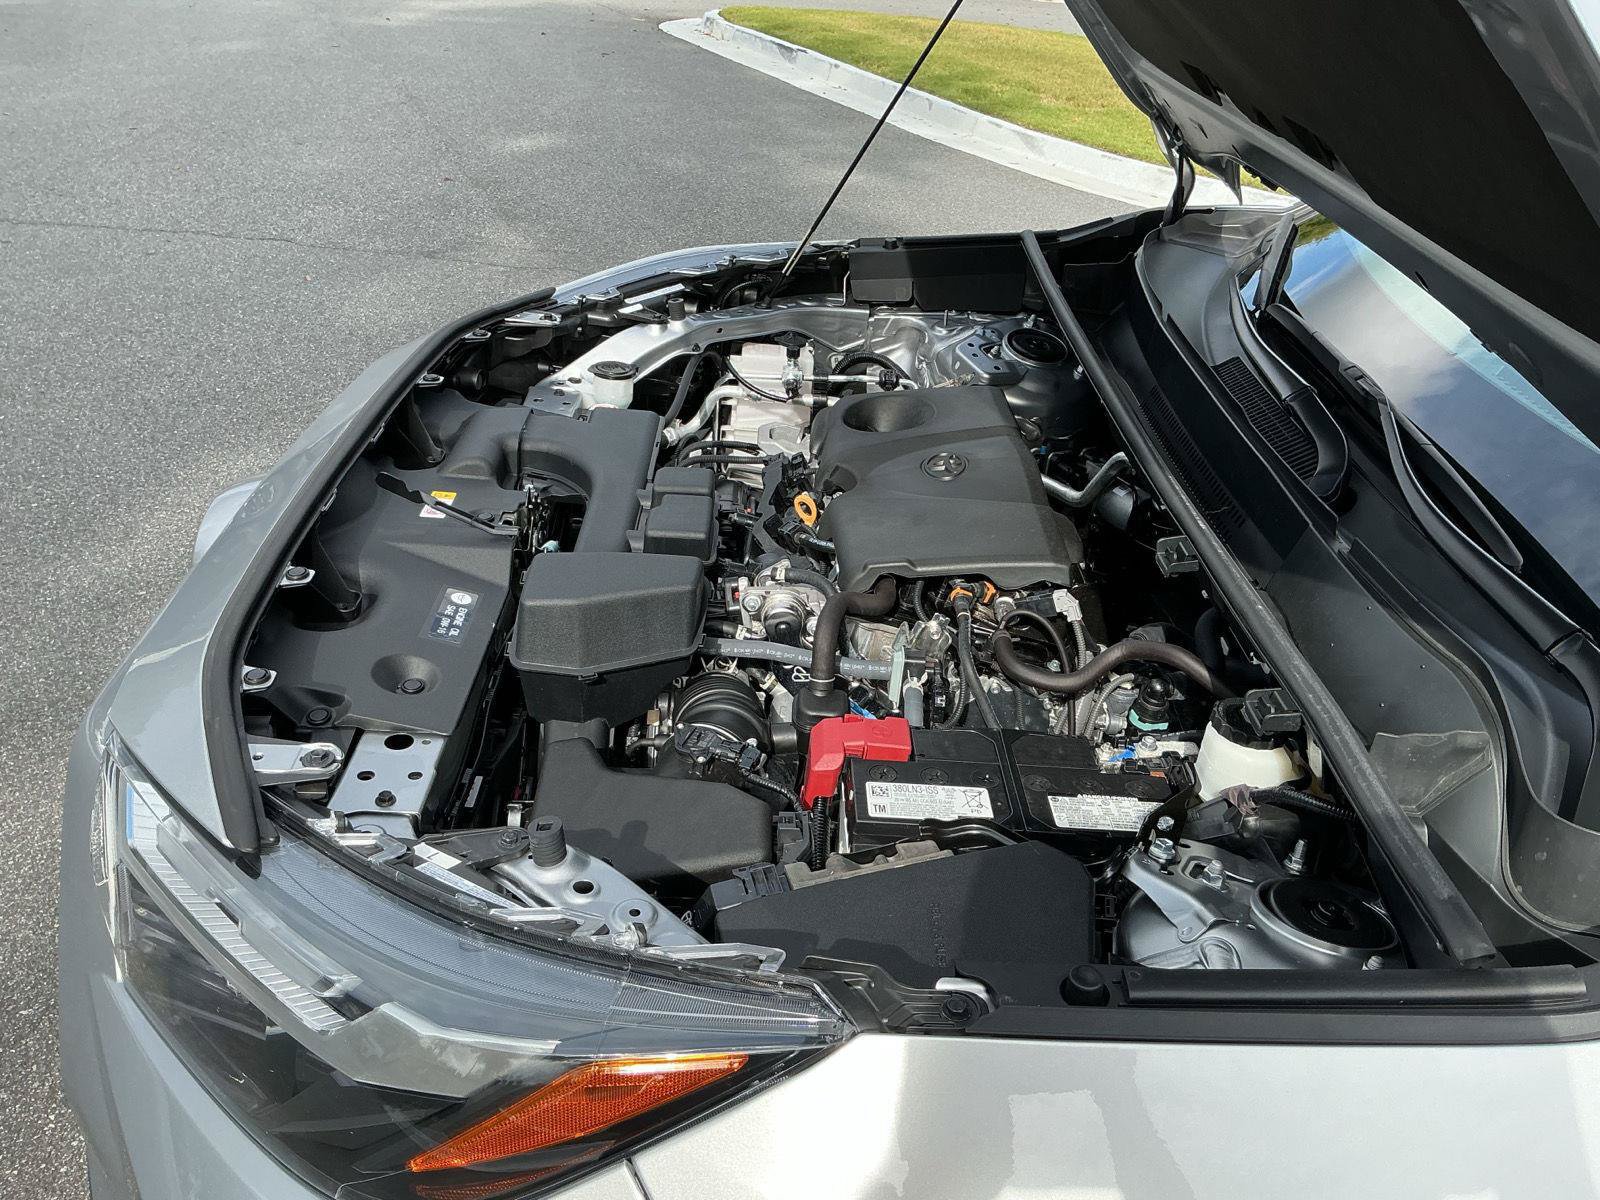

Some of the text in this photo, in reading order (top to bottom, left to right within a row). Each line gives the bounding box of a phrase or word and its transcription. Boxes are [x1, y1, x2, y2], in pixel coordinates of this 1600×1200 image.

[445, 605, 456, 616] SAE
[892, 784, 939, 795] 380LN3-ISS
[873, 804, 887, 814] TM
